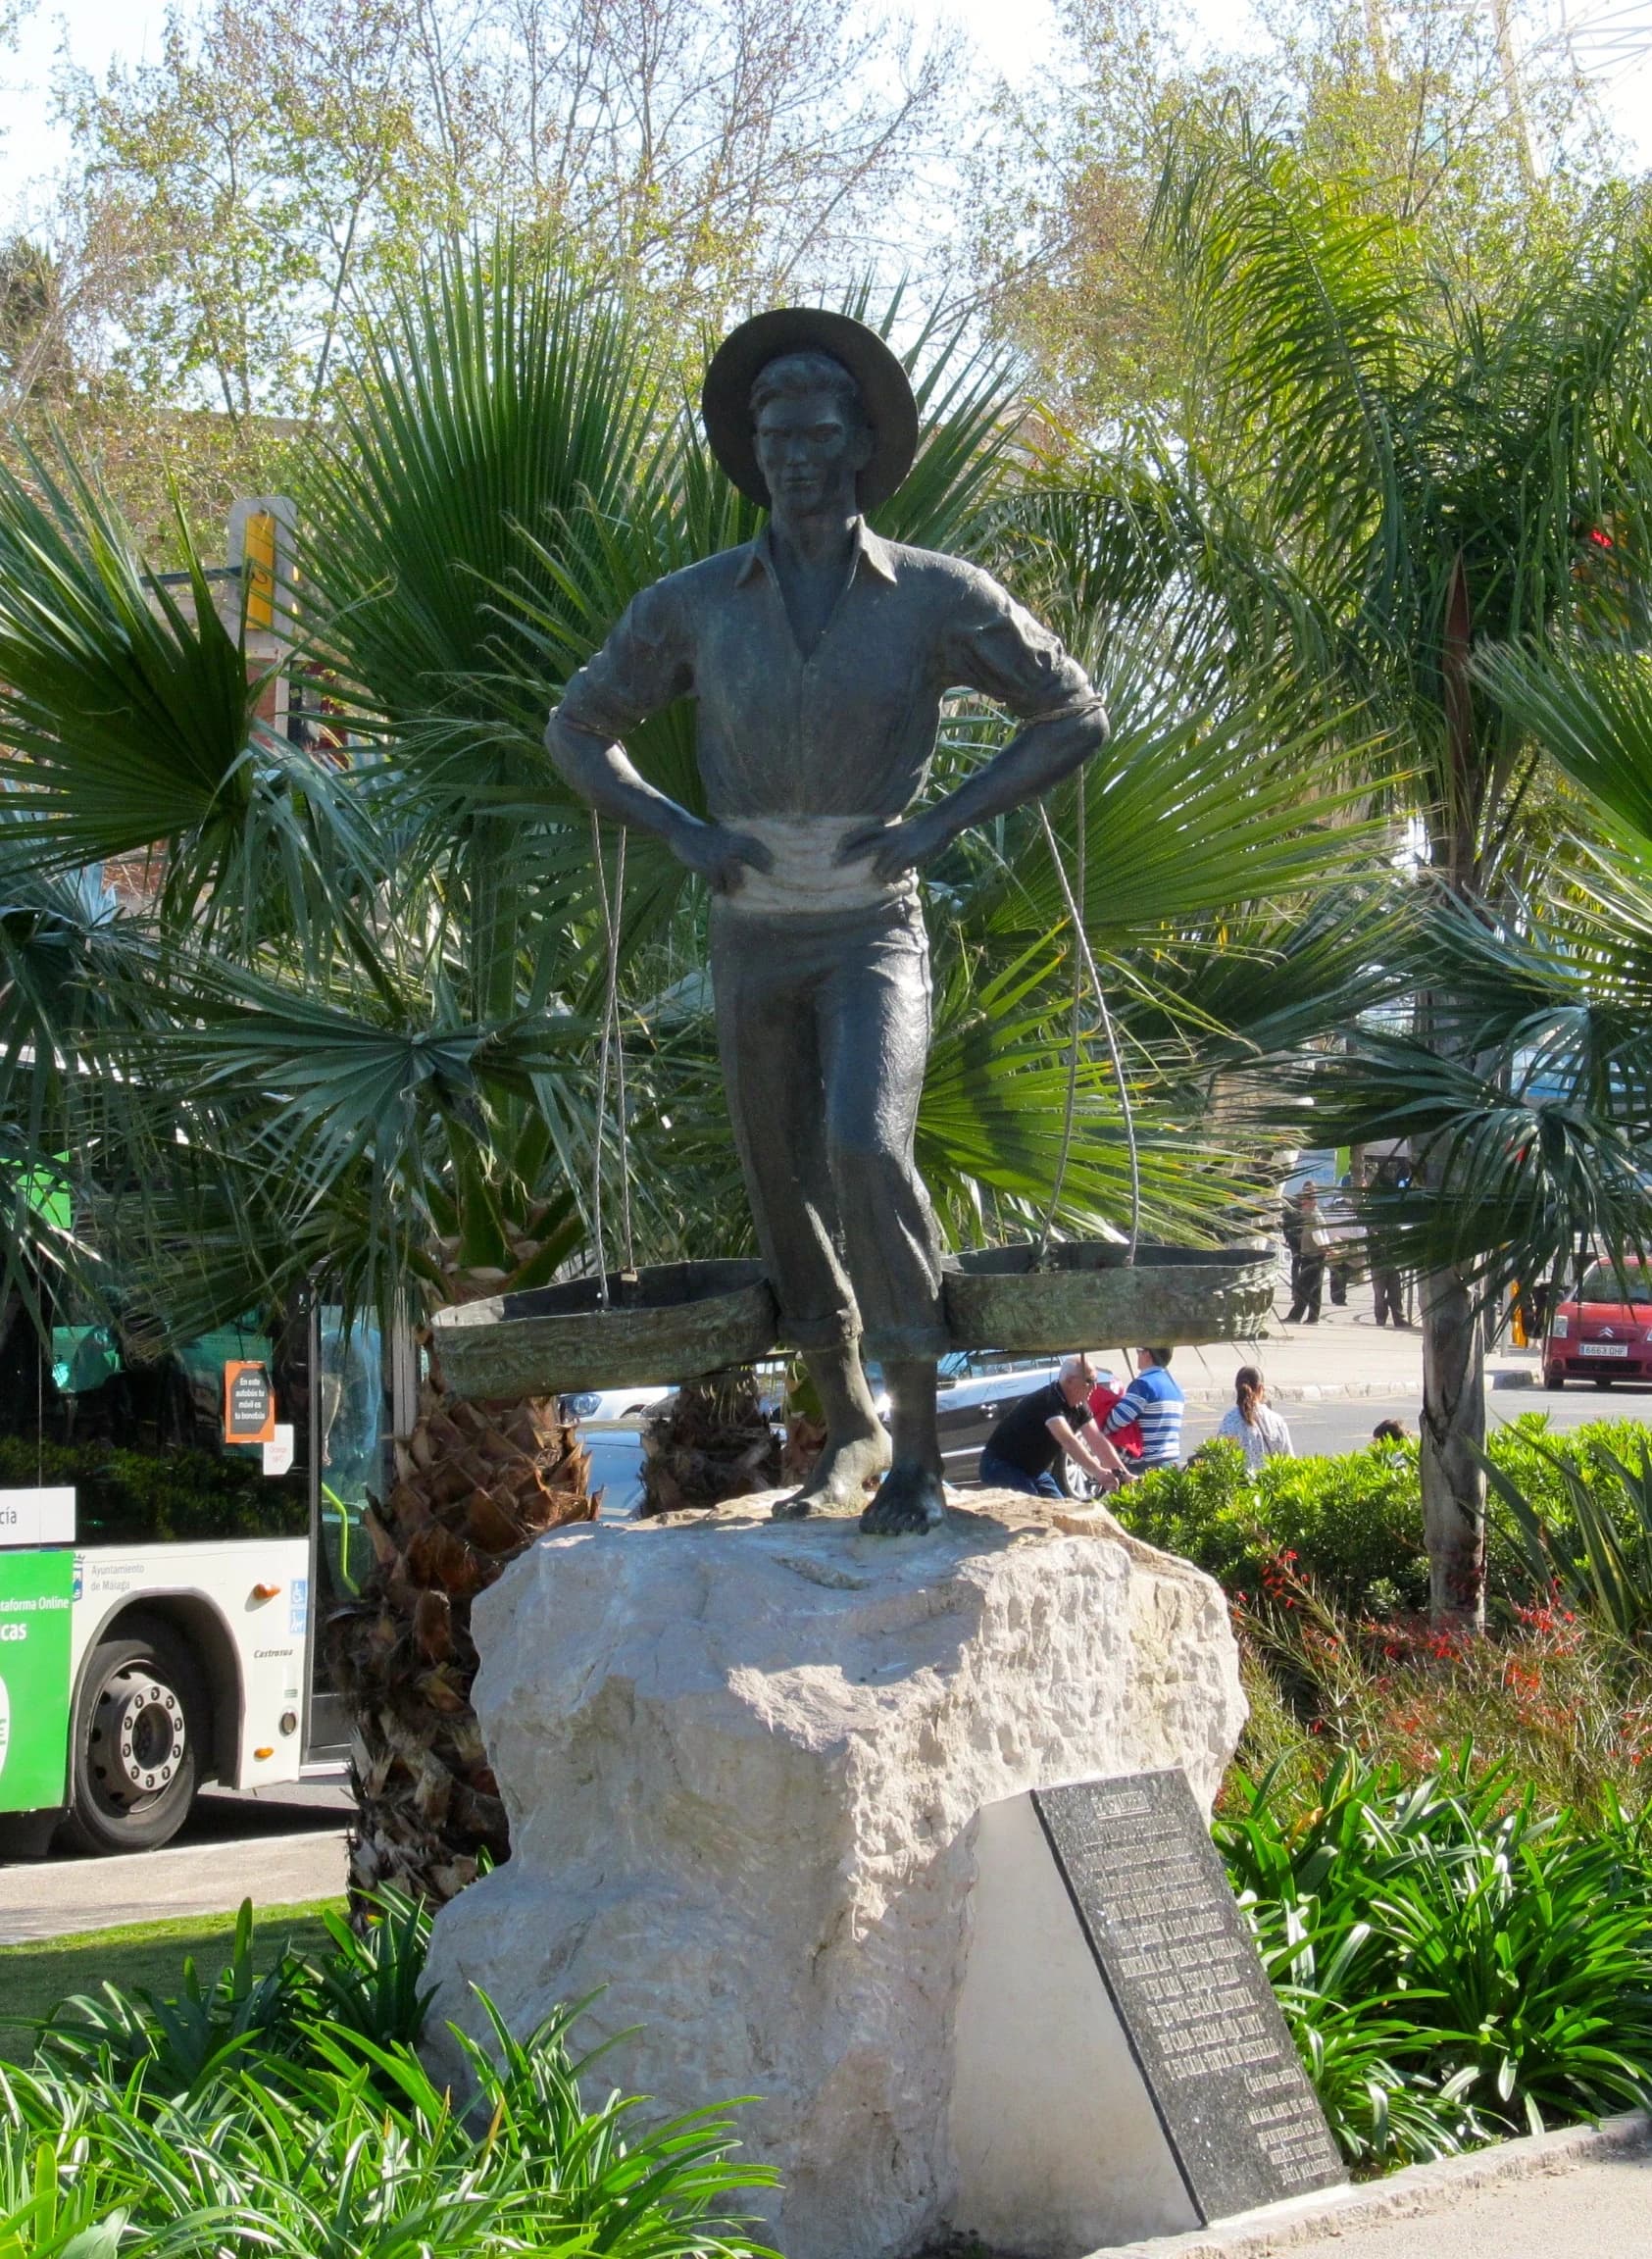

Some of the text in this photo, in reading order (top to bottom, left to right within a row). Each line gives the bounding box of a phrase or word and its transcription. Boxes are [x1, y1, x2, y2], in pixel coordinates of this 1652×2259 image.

[91, 1563, 145, 1579] Ayuntamiento
[90, 1580, 130, 1595] de Málaga
[39, 1595, 70, 1610] Online
[253, 1648, 294, 1659] Castrosua
